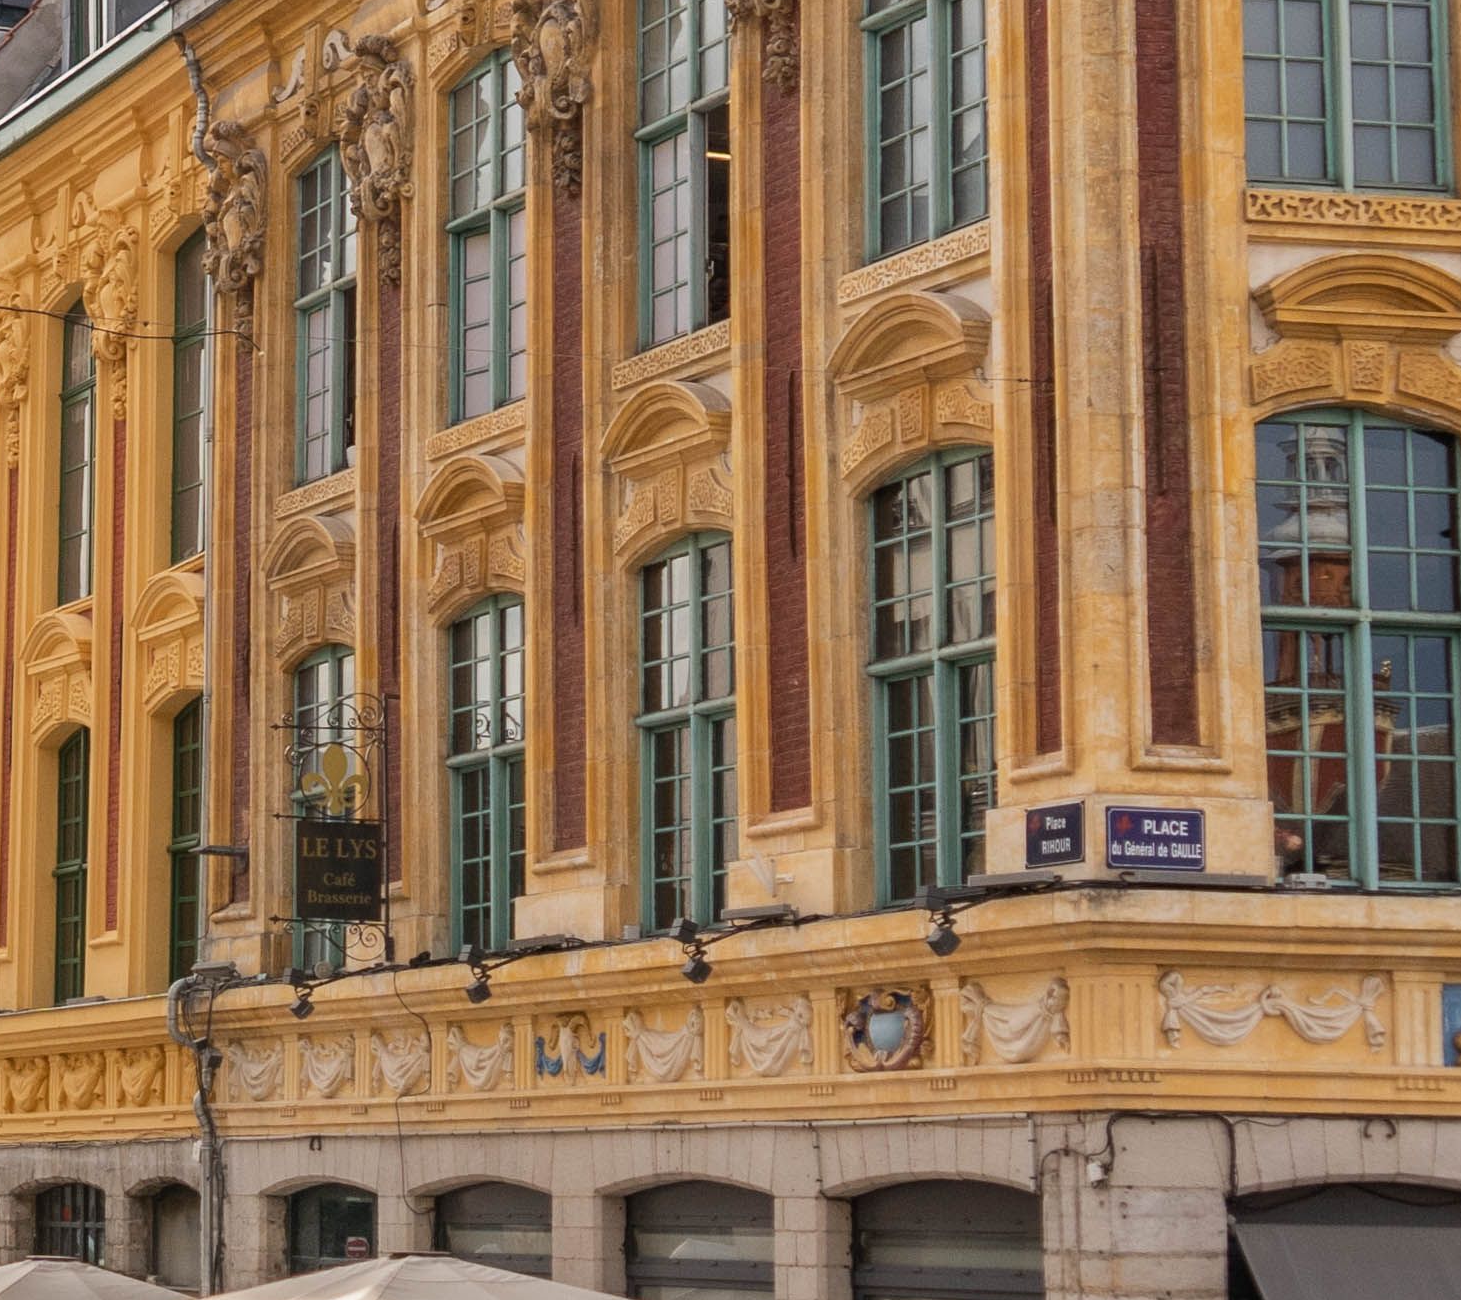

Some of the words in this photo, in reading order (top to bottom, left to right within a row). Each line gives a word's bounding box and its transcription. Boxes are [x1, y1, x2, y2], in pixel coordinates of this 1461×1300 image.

[1045, 816, 1067, 830] Place
[1143, 819, 1189, 836] PLACE
[301, 837, 330, 859] LE
[337, 837, 378, 860] LYS
[1041, 838, 1072, 855] RIHOUR
[1111, 842, 1123, 855] du
[1124, 840, 1156, 857] Général
[1158, 842, 1169, 857] de
[1171, 843, 1203, 859] GAULLE
[322, 872, 356, 888] Café
[306, 891, 373, 907] Brasserie
